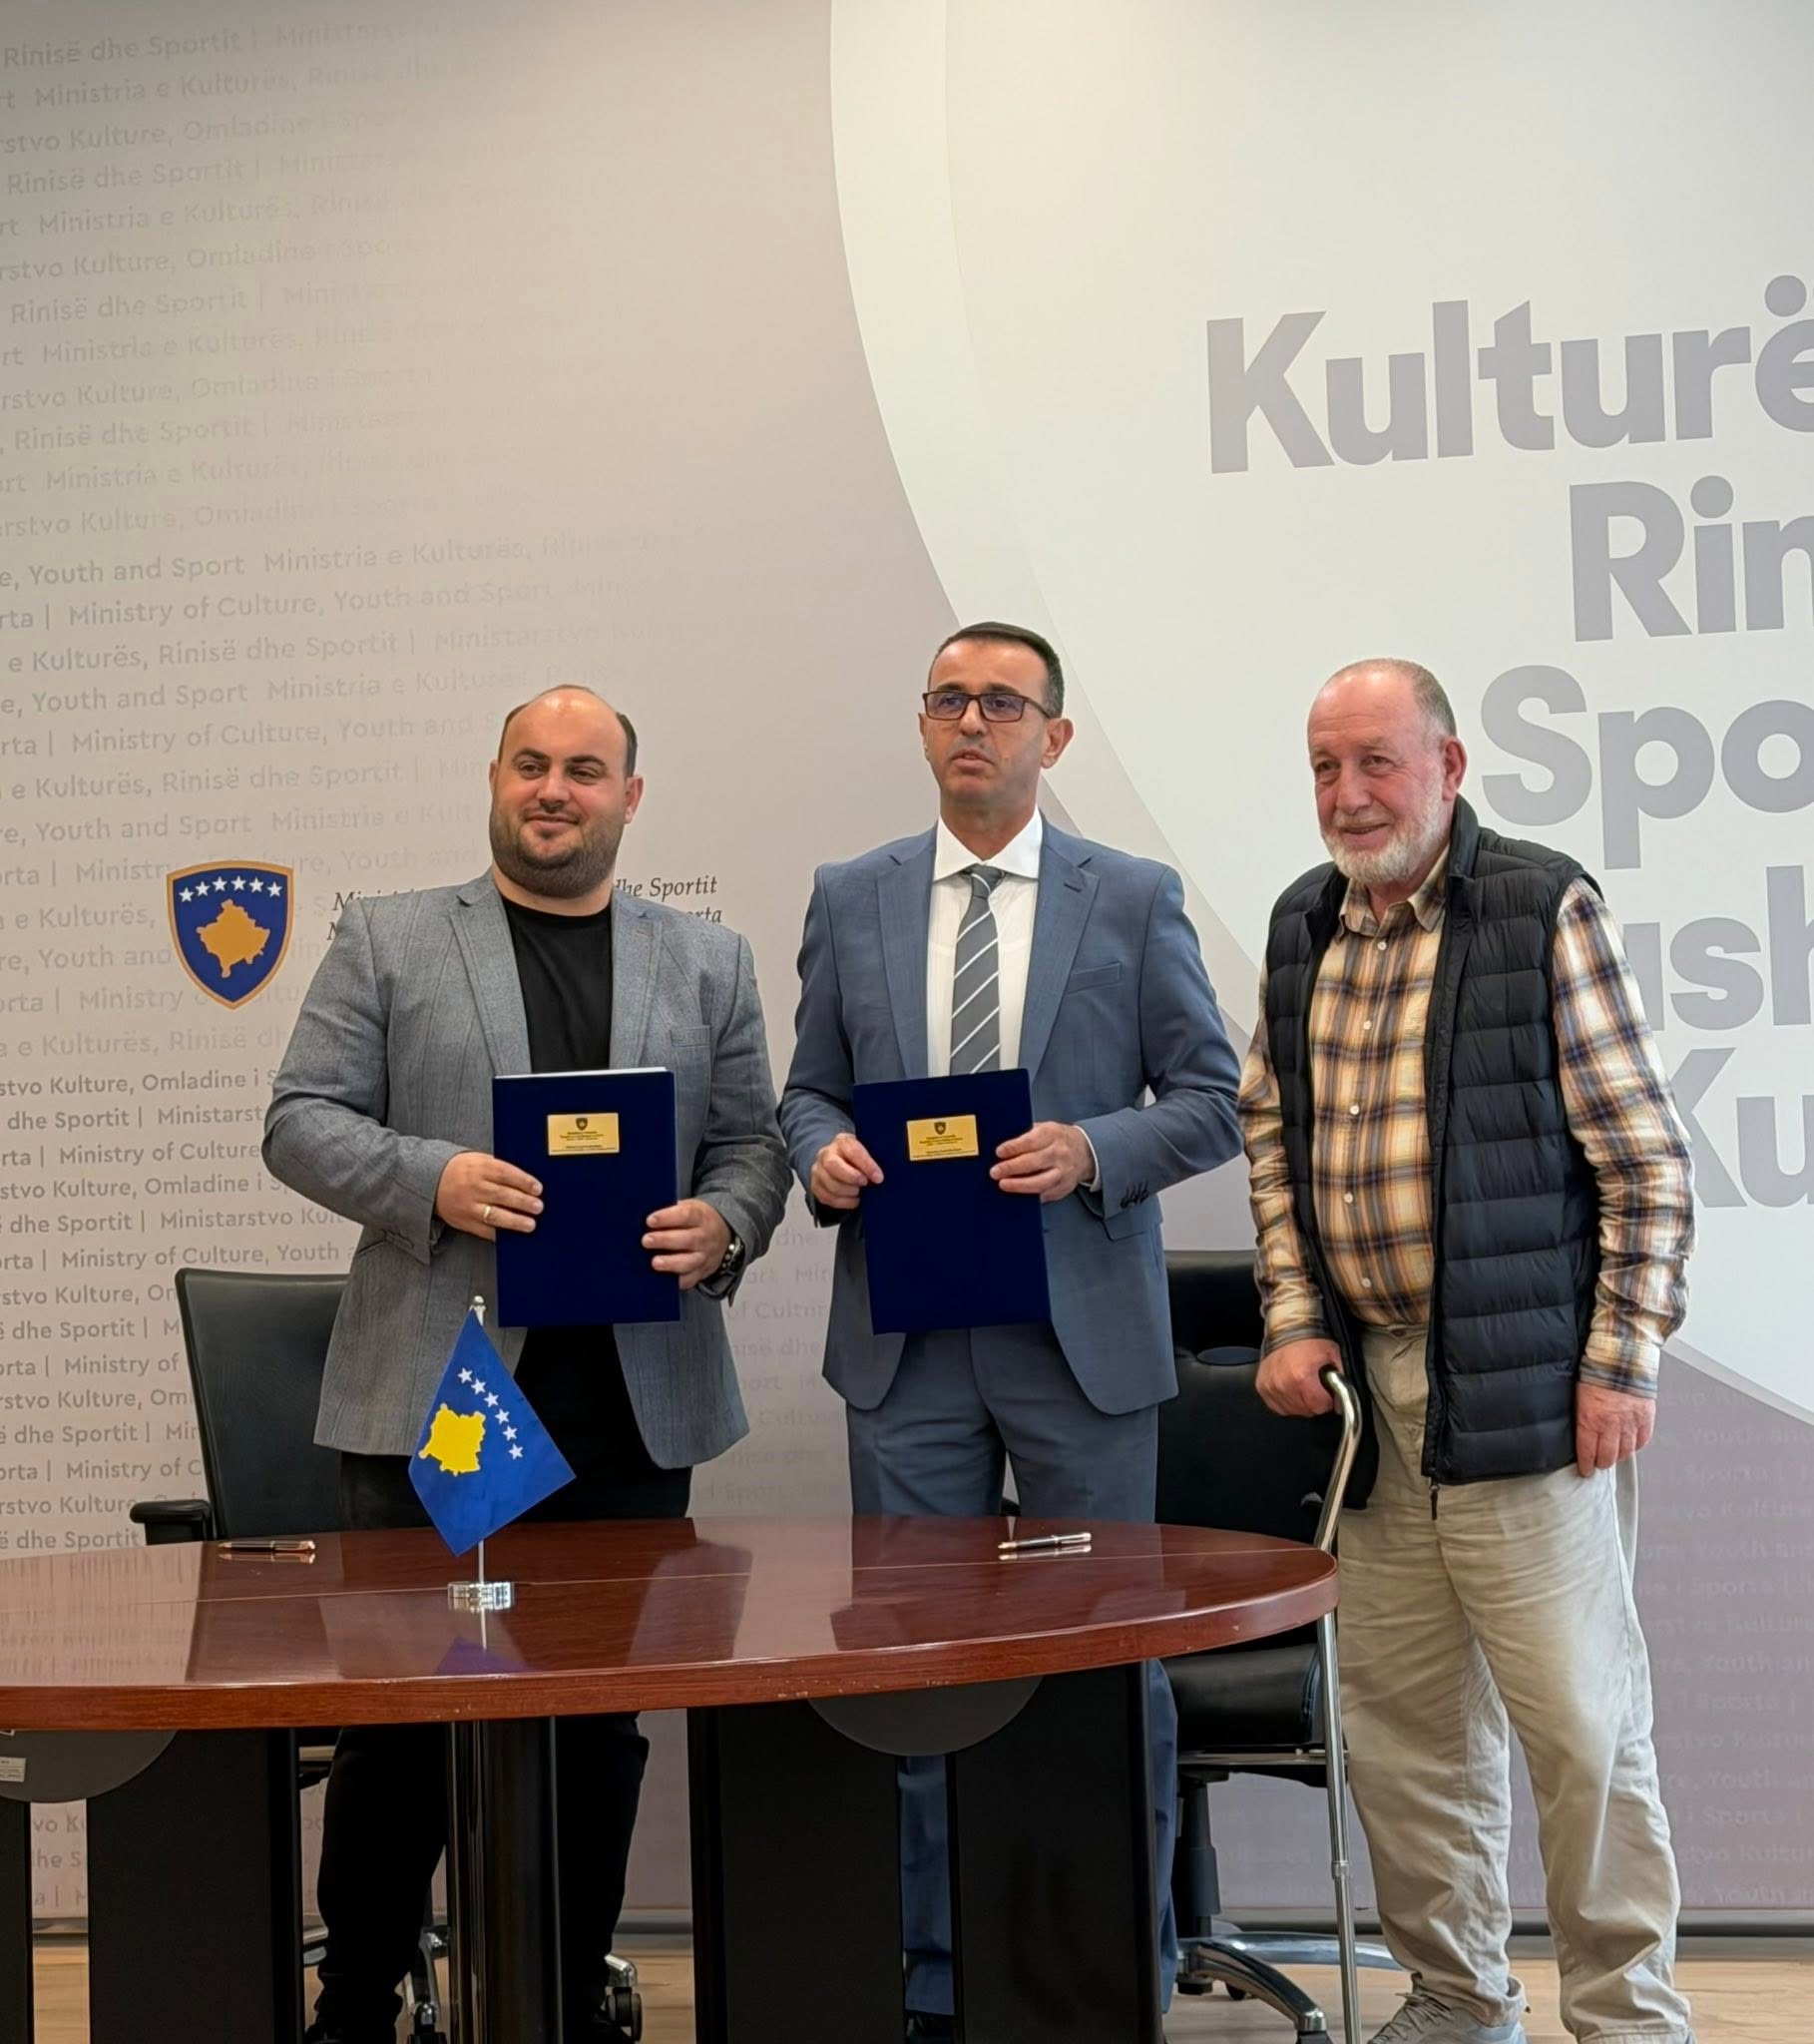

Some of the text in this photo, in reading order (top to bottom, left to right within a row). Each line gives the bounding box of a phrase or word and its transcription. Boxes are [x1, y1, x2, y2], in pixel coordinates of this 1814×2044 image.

[3, 28, 240, 68] Rinisë dhe Sportit
[35, 80, 146, 108] Ministria
[156, 82, 171, 98] e
[70, 123, 174, 150] Kulture,
[7, 157, 244, 195] Rinisë dhe Sportit
[39, 206, 150, 236] Ministria
[160, 210, 175, 226] e
[74, 250, 176, 277] Kulture,
[10, 297, 88, 324] Rinisë
[97, 294, 145, 319] dhe
[14, 424, 92, 451] Rinisë
[101, 421, 150, 446] dhe
[0, 513, 71, 538] rstvo
[28, 560, 104, 586] Youth
[114, 556, 162, 582] and
[172, 554, 245, 583] Sport
[264, 545, 377, 573] Ministria
[1570, 475, 1814, 642] Rin
[69, 601, 173, 628] Ministry
[184, 596, 210, 621] of
[217, 592, 325, 619] Culture,
[8, 656, 23, 673] e
[32, 645, 148, 672] Kulturës,
[160, 640, 235, 666] Rinisë
[246, 637, 295, 661] dhe
[32, 689, 107, 715] Youth
[117, 685, 166, 710] and
[176, 682, 249, 710] Sport
[267, 674, 381, 702] Ministria
[72, 729, 176, 755] Ministry
[188, 723, 215, 747] of
[221, 720, 327, 746] Culture,
[1481, 665, 1814, 870] Spo
[36, 771, 152, 799] Kulturës,
[163, 766, 239, 792] Rinisë
[249, 765, 298, 788] dhe
[35, 818, 111, 844] Youth
[121, 814, 169, 839] and
[180, 812, 252, 840] Sport
[0, 865, 40, 886] rta
[650, 874, 717, 902] Sportit
[39, 902, 155, 930] Kulturës,
[38, 947, 114, 970] Youth
[80, 985, 184, 1014] Ministry
[42, 1030, 160, 1058] Kulturës,
[50, 1072, 135, 1097] Kulture,
[142, 1070, 246, 1092] Omladine
[7, 1103, 263, 1133] dhe Sportit Ministarst
[60, 1144, 144, 1168] Ministry
[152, 1141, 174, 1162] of
[53, 1178, 137, 1201] Kulture,
[145, 1173, 249, 1196] Omladine
[10, 1208, 293, 1236] dhe Sportit Ministarstvo
[0, 1240, 339, 1273] rta Ministry of Culture, Youth
[0, 1287, 47, 1305] stvo
[55, 1282, 140, 1306] Kulture,
[755, 1297, 827, 1319] Cultur
[12, 1319, 52, 1340] dhe
[60, 1316, 135, 1342] Sportit
[64, 1353, 150, 1377] Ministry
[158, 1351, 180, 1372] of
[58, 1388, 143, 1411] Kulture,
[14, 1421, 138, 1446] dhe Sportit
[67, 1458, 152, 1482] Ministry
[160, 1456, 182, 1476] of
[60, 1493, 136, 1514] Kultur
[17, 1528, 57, 1549] dhe
[65, 1525, 139, 1550] Sportit
